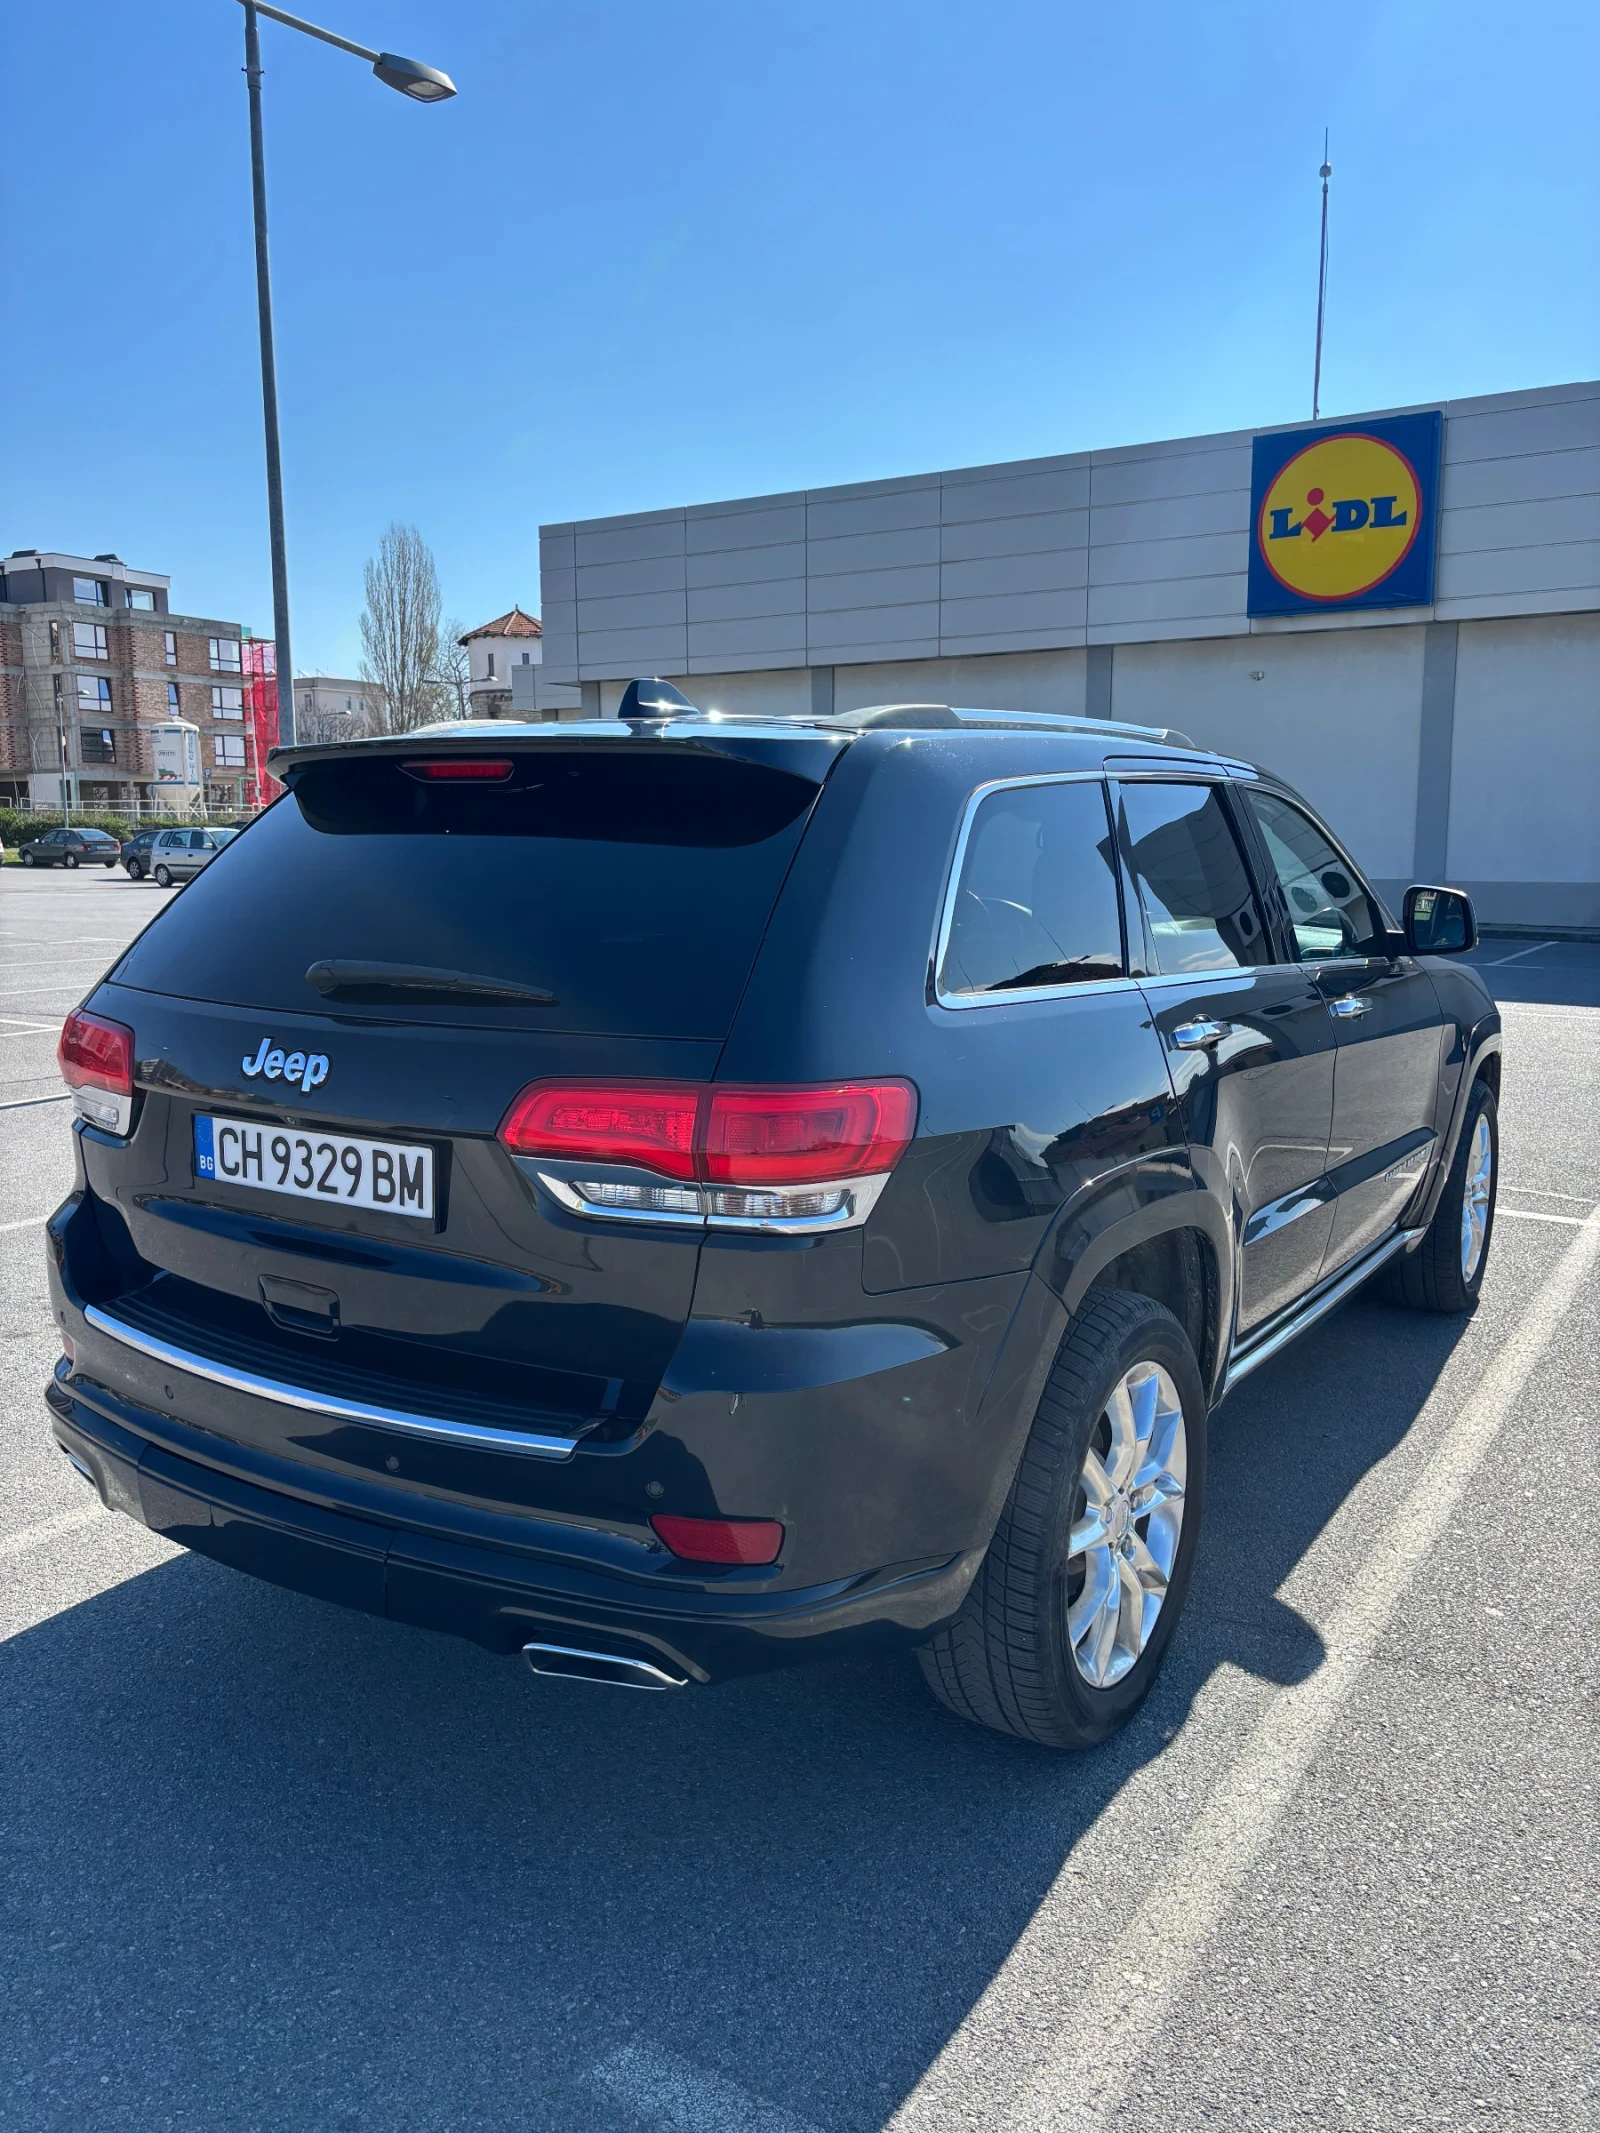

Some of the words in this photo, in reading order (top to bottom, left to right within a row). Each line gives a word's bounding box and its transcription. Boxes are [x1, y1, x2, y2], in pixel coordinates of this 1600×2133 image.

[241, 1037, 330, 1093] Jeep
[199, 1155, 214, 1171] BG
[271, 1136, 363, 1198] 9329
